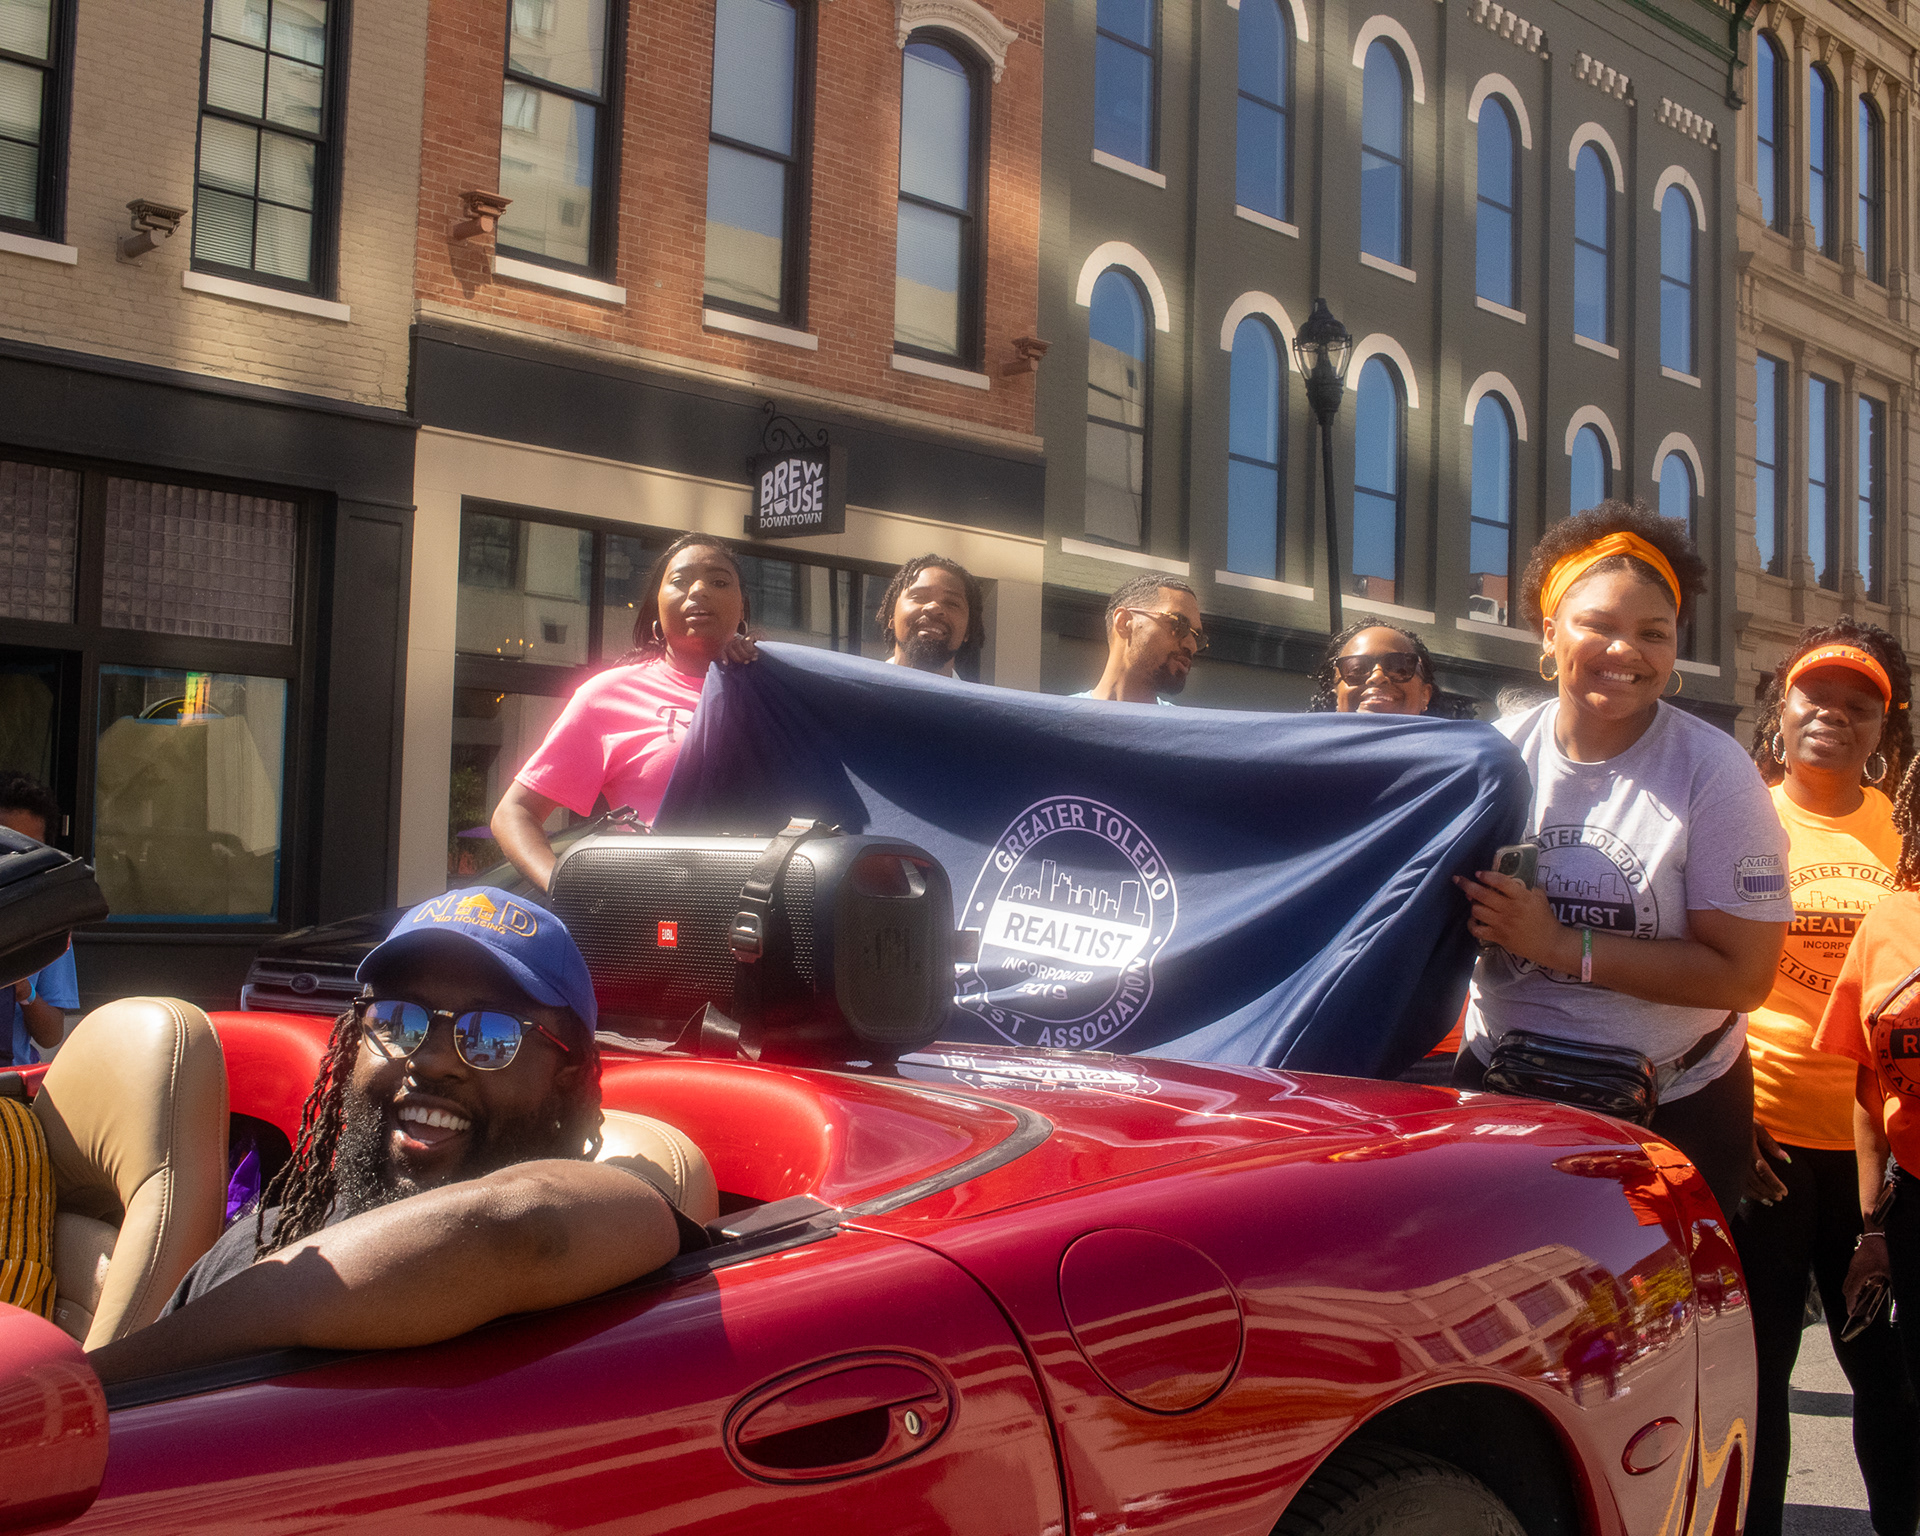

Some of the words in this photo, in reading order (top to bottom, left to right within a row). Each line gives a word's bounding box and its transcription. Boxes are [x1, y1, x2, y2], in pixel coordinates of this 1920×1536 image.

[761, 458, 823, 507] BREW
[760, 512, 823, 529] DOWNTOWN
[994, 803, 1086, 873] GREATER
[1092, 807, 1170, 900] TOLEDO
[1590, 831, 1643, 885] TOLEDO
[1746, 857, 1779, 867] NAREB
[1790, 866, 1842, 889] EATER
[1848, 866, 1903, 892] TOLED
[454, 915, 507, 935] HOUSING
[1550, 903, 1620, 927] LTIST
[1791, 915, 1864, 934] REALT
[661, 928, 675, 940] JBL
[1003, 911, 1133, 960] REALTIST
[1803, 940, 1851, 950] INCORPO
[1780, 957, 1832, 990] LTIST
[1036, 957, 1147, 1048] ASSOCIATION
